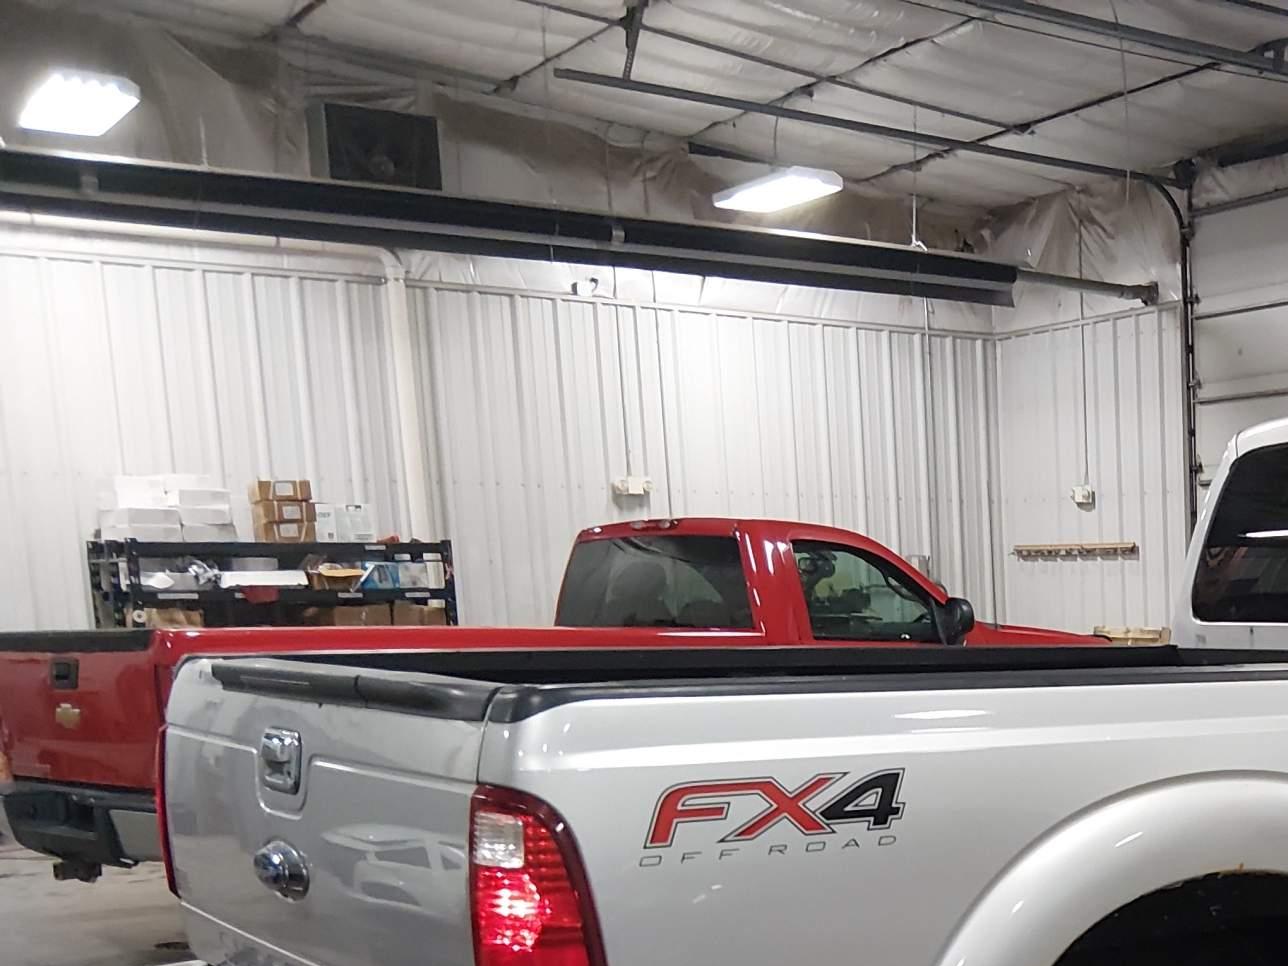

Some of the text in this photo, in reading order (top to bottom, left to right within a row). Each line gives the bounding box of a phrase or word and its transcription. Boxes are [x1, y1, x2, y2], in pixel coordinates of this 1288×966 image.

[643, 767, 906, 850] FX4
[639, 834, 897, 867] OFF ROAD
